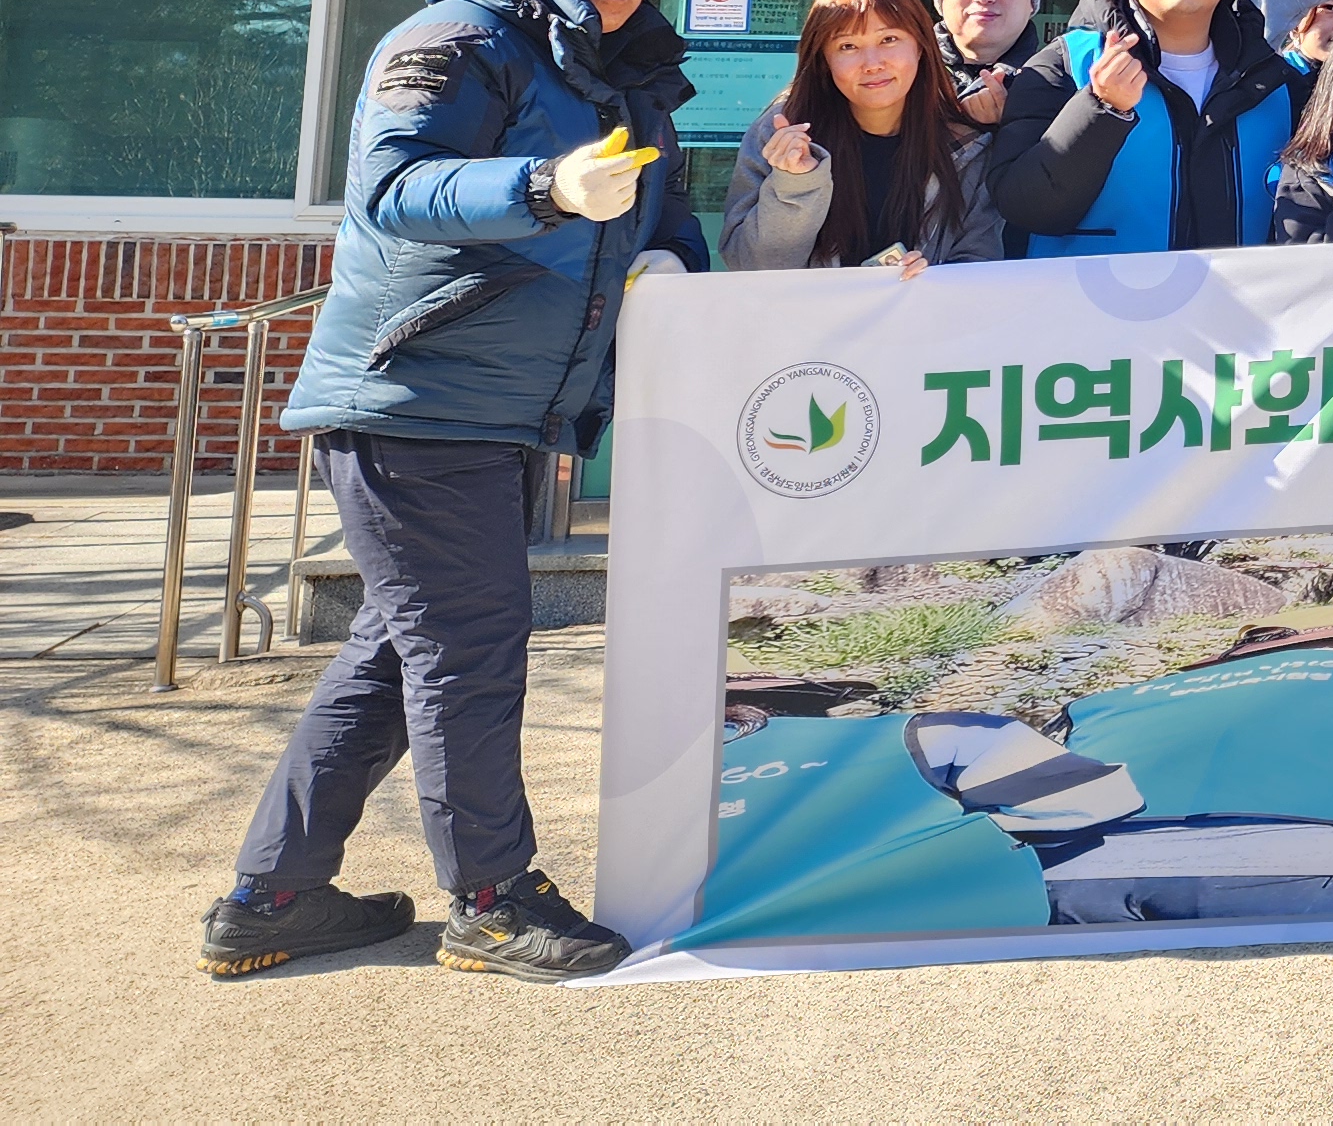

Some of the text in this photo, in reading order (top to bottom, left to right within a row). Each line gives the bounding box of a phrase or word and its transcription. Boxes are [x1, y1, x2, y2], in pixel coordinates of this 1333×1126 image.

[745, 367, 874, 462] GYEONGSANGNAMDO YANGSAN OFFICE OF EDUCATION
[760, 461, 858, 492] 경상남도양산교육지원청
